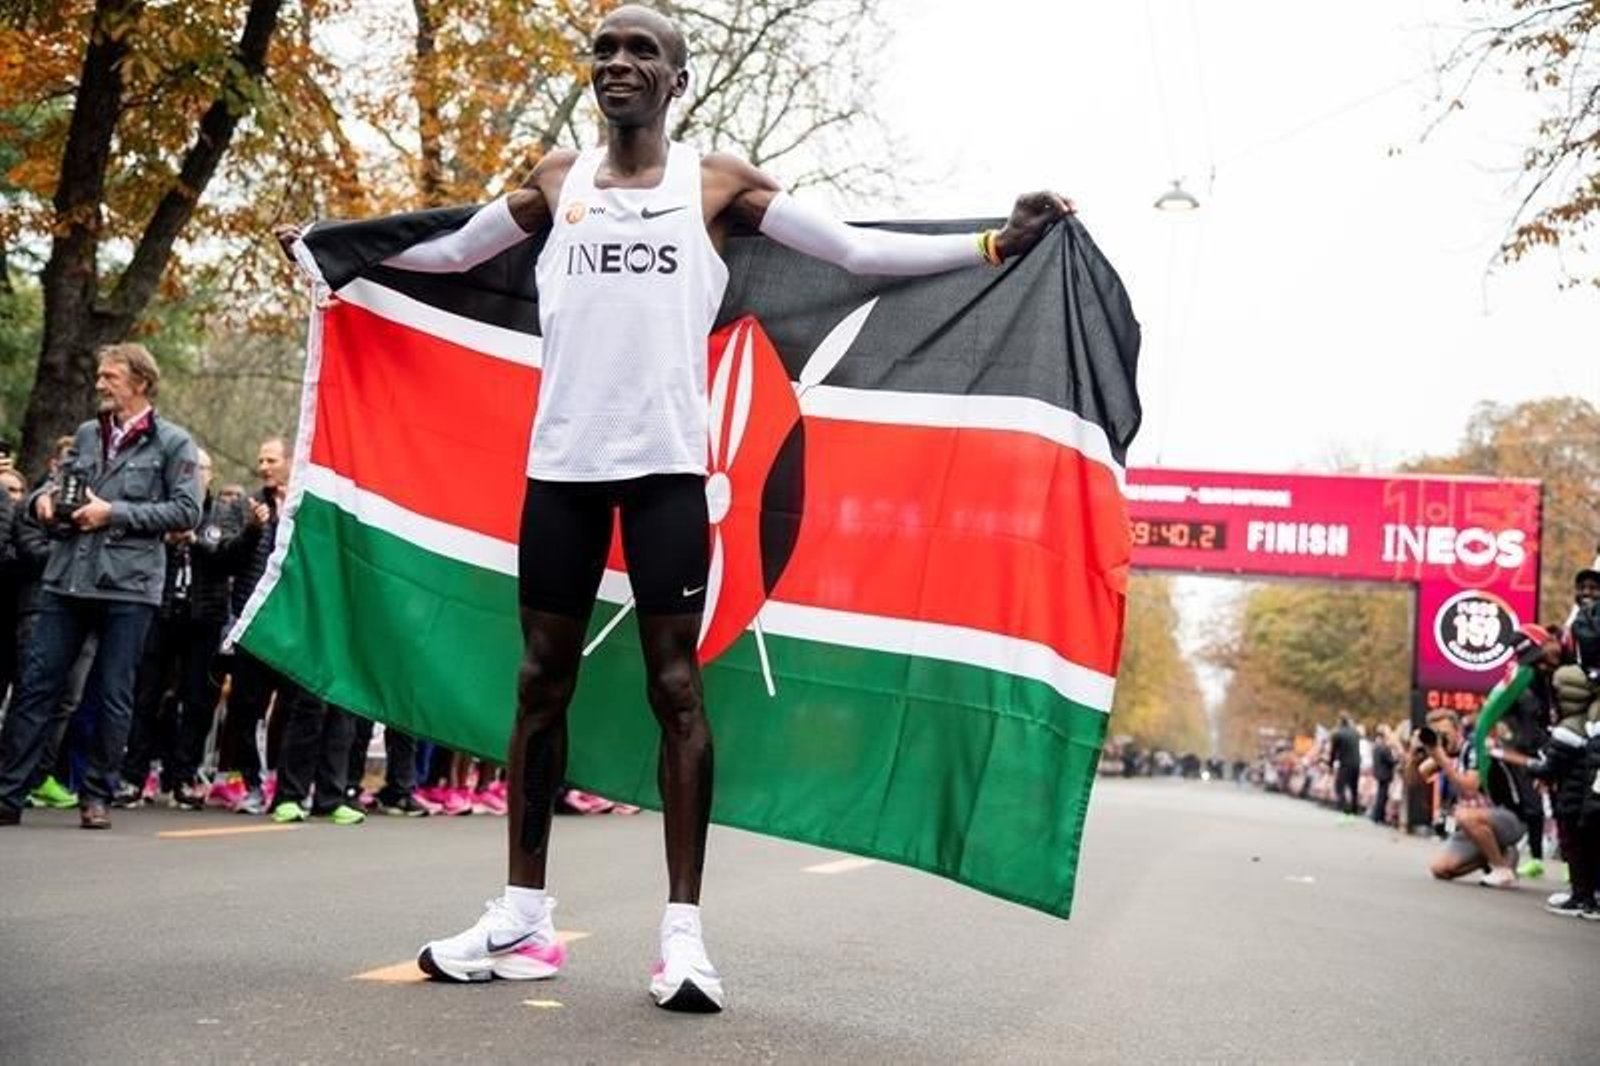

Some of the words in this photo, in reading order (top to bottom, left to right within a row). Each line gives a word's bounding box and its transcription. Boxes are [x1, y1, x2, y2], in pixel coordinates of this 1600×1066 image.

[589, 206, 606, 215] NN
[566, 242, 678, 276] INEOS
[1246, 520, 1349, 557] FINISH
[1381, 523, 1526, 569] INEOS
